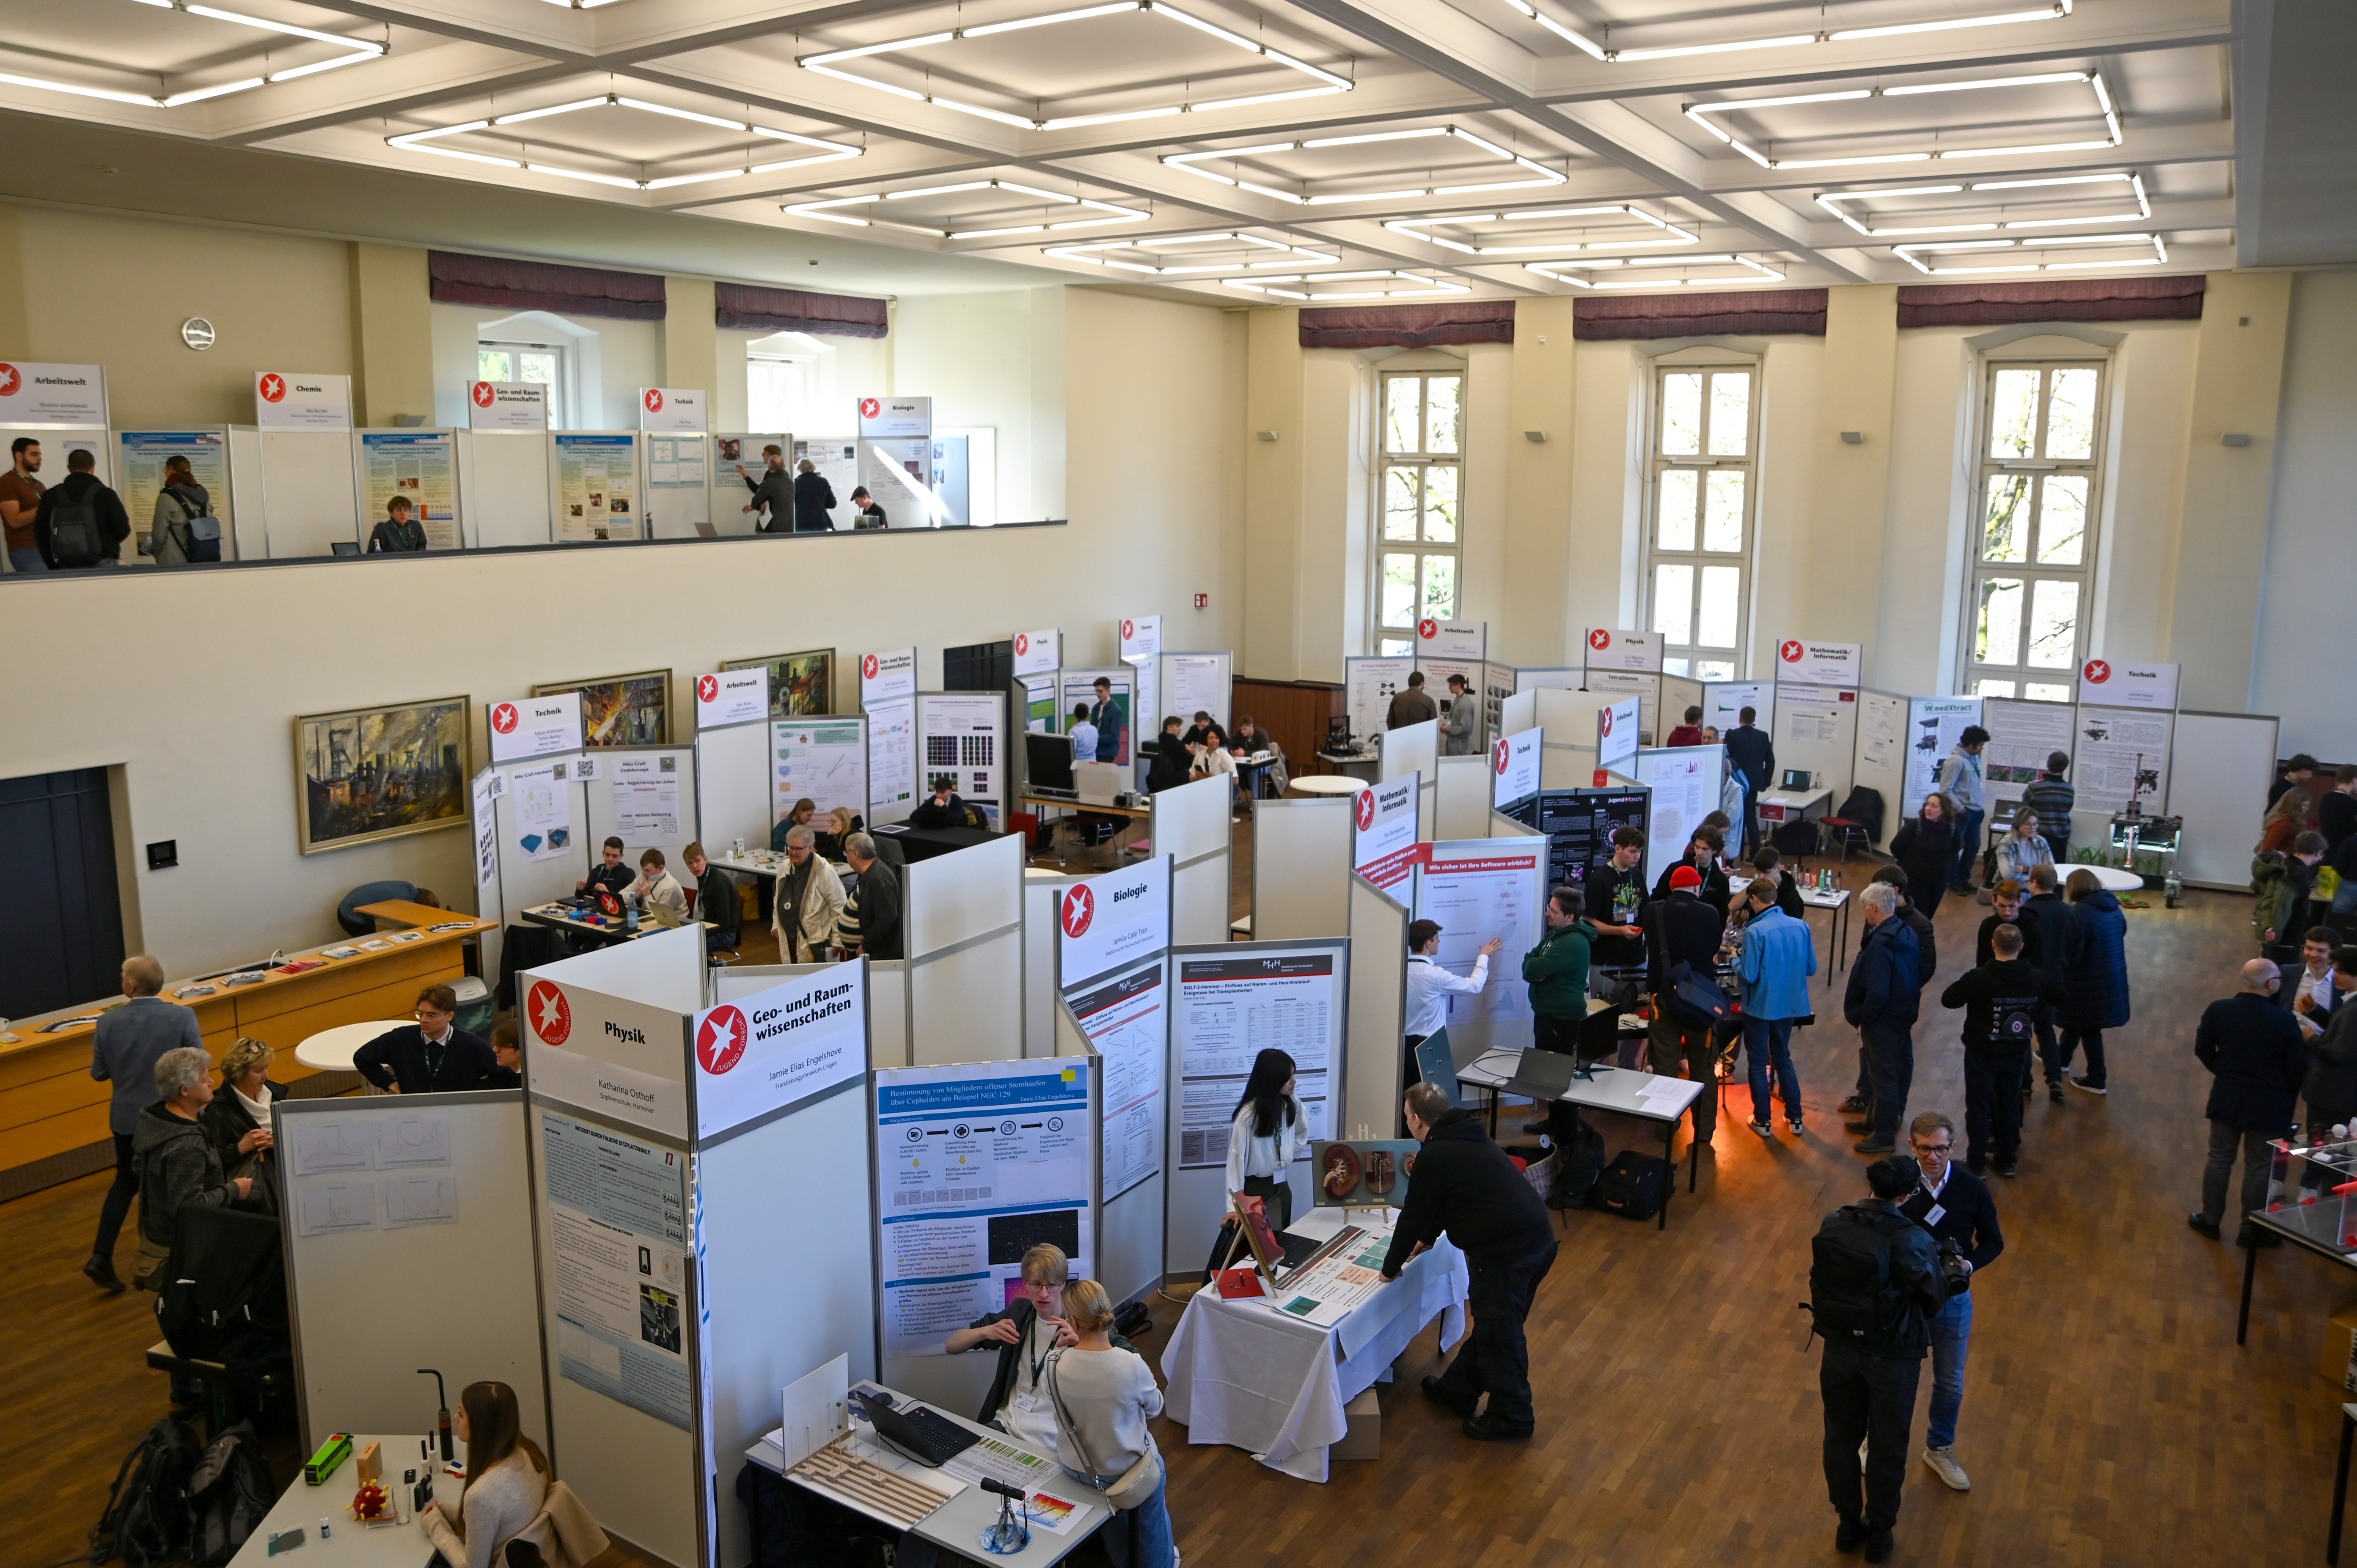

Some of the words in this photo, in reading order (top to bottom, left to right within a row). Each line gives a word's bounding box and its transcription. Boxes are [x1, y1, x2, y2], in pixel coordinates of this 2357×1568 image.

[35, 377, 86, 385] Arbeitswelt
[880, 662, 910, 671] wissenschaften
[726, 680, 756, 689] Arbeitswelt
[535, 707, 561, 716] Technik
[1617, 710, 1633, 721] Arbeitswelt
[1517, 744, 1530, 754] Technik
[1380, 784, 1410, 803] Mathematik/
[1382, 797, 1407, 813] Informatik
[1114, 883, 1147, 902] Biologie
[1073, 922, 1089, 936] JUGEND
[1113, 932, 1137, 945] Jamila-Cate
[1138, 927, 1147, 935] Tran
[1106, 946, 1124, 956] Medizinische
[1125, 940, 1141, 949] Hochschule
[1141, 935, 1154, 943] Hannover
[1263, 960, 1280, 969] MHH
[1119, 979, 1130, 991] MHH
[753, 1008, 782, 1024] Geo-
[786, 993, 810, 1013] und
[814, 982, 853, 1003] Raum-
[545, 1034, 564, 1043] JUGEND
[561, 1001, 569, 1035] FORSCHT
[756, 999, 851, 1041] wissenschaften
[605, 1021, 645, 1044] Physik
[716, 1053, 740, 1071] JUGEND
[737, 1016, 746, 1051] FORSCHT
[769, 1067, 788, 1081] Jamie
[790, 1062, 804, 1073] Elias
[806, 1047, 842, 1067] Engelshove
[776, 1066, 822, 1089] Franziskusgymnasium
[823, 1061, 837, 1071] Lingen
[599, 1079, 628, 1095] Katharina
[630, 1089, 654, 1103] Osthoff
[890, 1088, 930, 1097] Bestimmung
[946, 1084, 983, 1093] Mitgliedern
[600, 1092, 632, 1108] Sophienschule,
[633, 1103, 654, 1114] Hannover
[891, 1098, 905, 1106] über
[907, 1095, 940, 1105] Cepheiden
[953, 1093, 979, 1101] Beispiel
[575, 1125, 590, 1135] INFIZIERT
[591, 1131, 602, 1139] DURCH
[603, 1135, 618, 1144] FALSCHE
[619, 1140, 650, 1155] SITZPLATZWAHL?!
[599, 1146, 620, 1157] FRAGESTELLUNG
[600, 1164, 617, 1172] HYPOTHESEN
